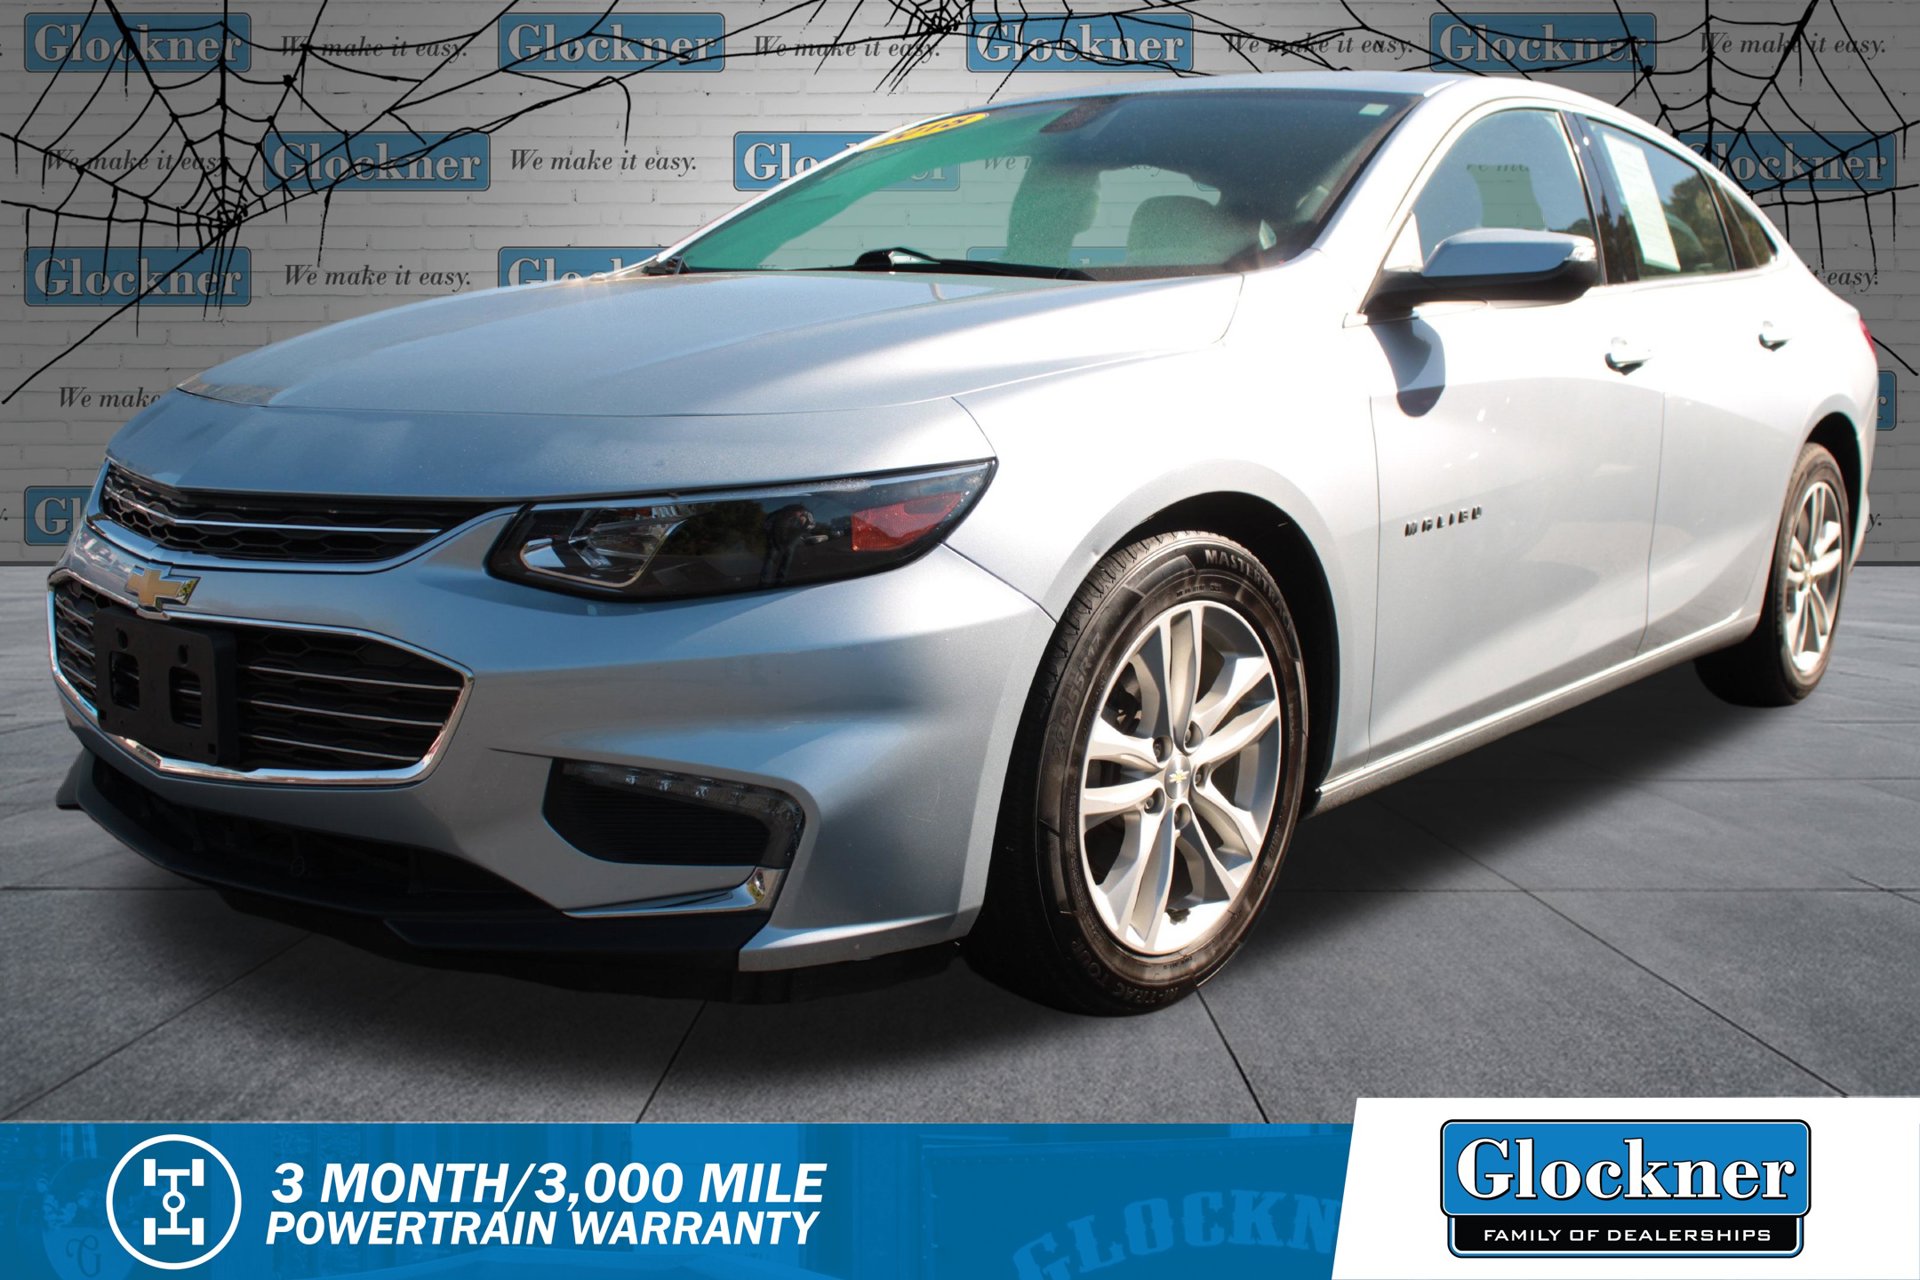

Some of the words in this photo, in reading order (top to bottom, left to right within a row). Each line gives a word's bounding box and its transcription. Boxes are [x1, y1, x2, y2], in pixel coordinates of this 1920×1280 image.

[33, 22, 242, 63] Glockner
[321, 36, 384, 57] make
[391, 36, 408, 57] it
[415, 41, 468, 64] easy.
[506, 22, 717, 63] Glockner
[753, 35, 787, 57] We
[794, 35, 856, 57] make
[863, 36, 881, 57] it
[888, 41, 941, 64] easy.
[975, 22, 1186, 63] Glockner
[1227, 32, 1260, 54] We
[1337, 34, 1354, 54] it
[1361, 38, 1413, 61] easy.
[1438, 22, 1648, 63] Glockner
[1699, 31, 1732, 54] We
[1740, 31, 1802, 54] make
[1810, 32, 1827, 54] it
[1834, 39, 1886, 61] easy.
[88, 148, 150, 170] make
[157, 150, 174, 170] it
[273, 141, 482, 181] Glockner
[510, 148, 544, 171] We
[551, 148, 614, 171] make
[620, 149, 638, 171] it
[644, 154, 697, 178] easy.
[33, 257, 242, 297] Glockner
[284, 263, 318, 286] We
[325, 263, 388, 286] make
[395, 264, 412, 286] it
[418, 270, 472, 292] easy.
[1827, 271, 1879, 293] easy.
[59, 386, 92, 408] We
